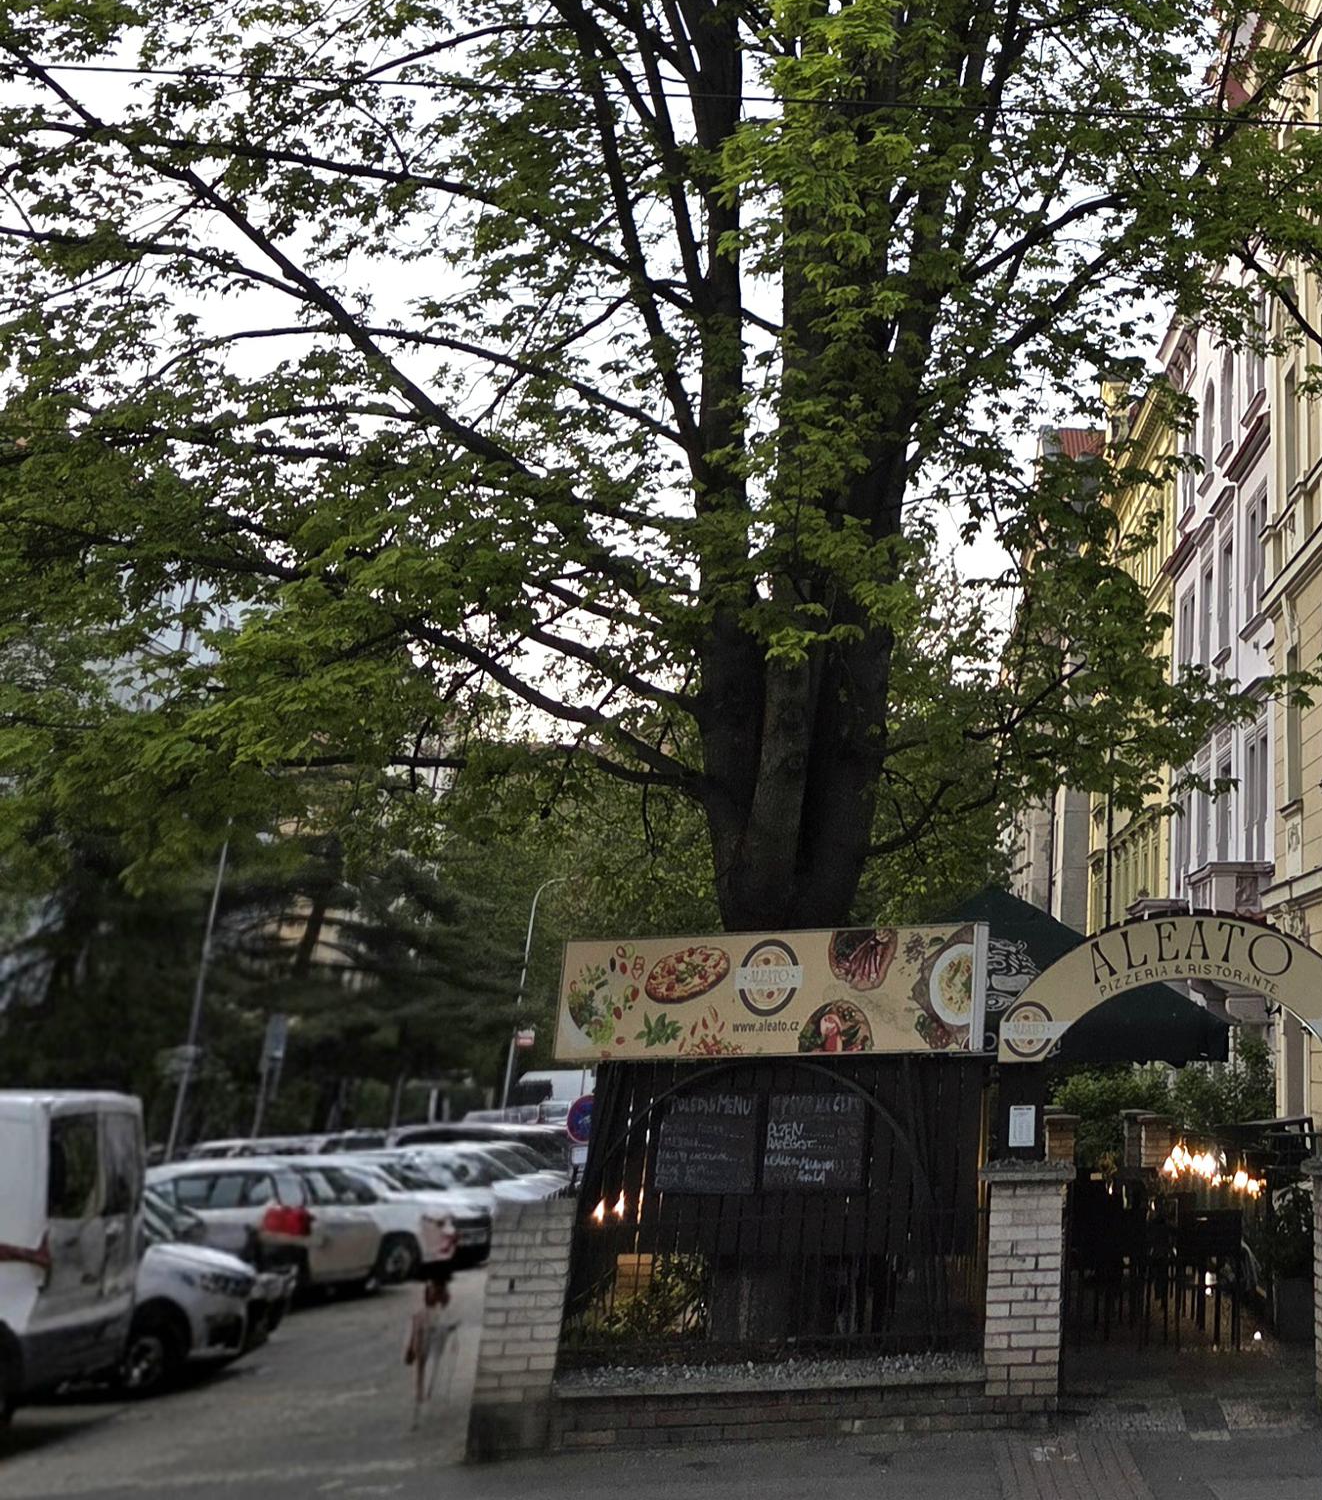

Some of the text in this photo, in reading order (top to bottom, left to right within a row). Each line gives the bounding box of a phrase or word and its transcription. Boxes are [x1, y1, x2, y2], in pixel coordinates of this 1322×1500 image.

[1089, 920, 1293, 984] ALEATO
[1100, 964, 1280, 997] PIZZERIA & RISTORANTE
[732, 1019, 799, 1033] www.aleato.cz
